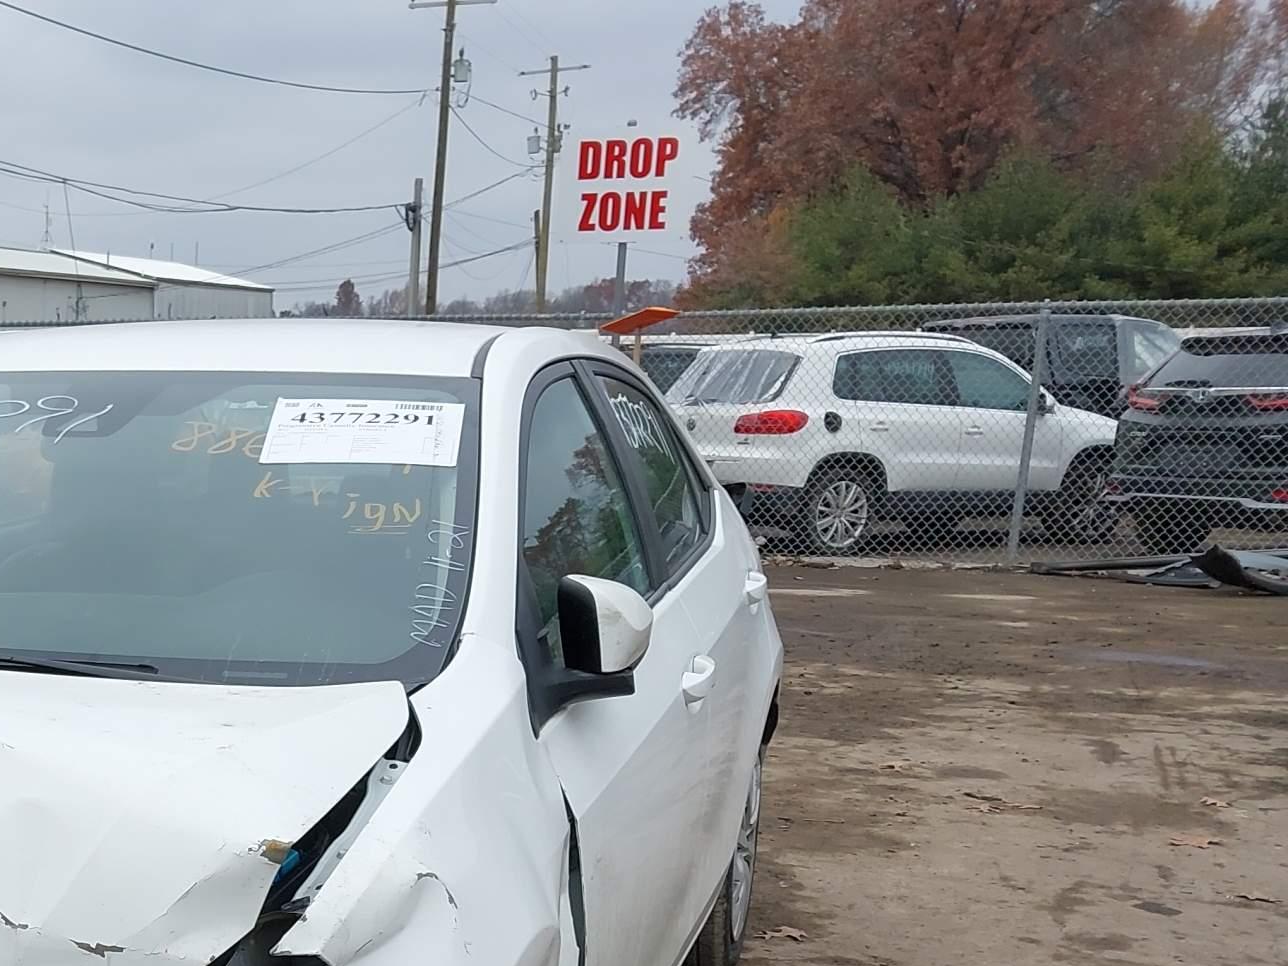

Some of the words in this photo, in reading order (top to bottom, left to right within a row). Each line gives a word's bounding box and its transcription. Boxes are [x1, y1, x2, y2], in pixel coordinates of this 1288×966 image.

[578, 137, 679, 180] DROP
[578, 190, 668, 231] ZONE
[291, 411, 434, 426] 43772291
